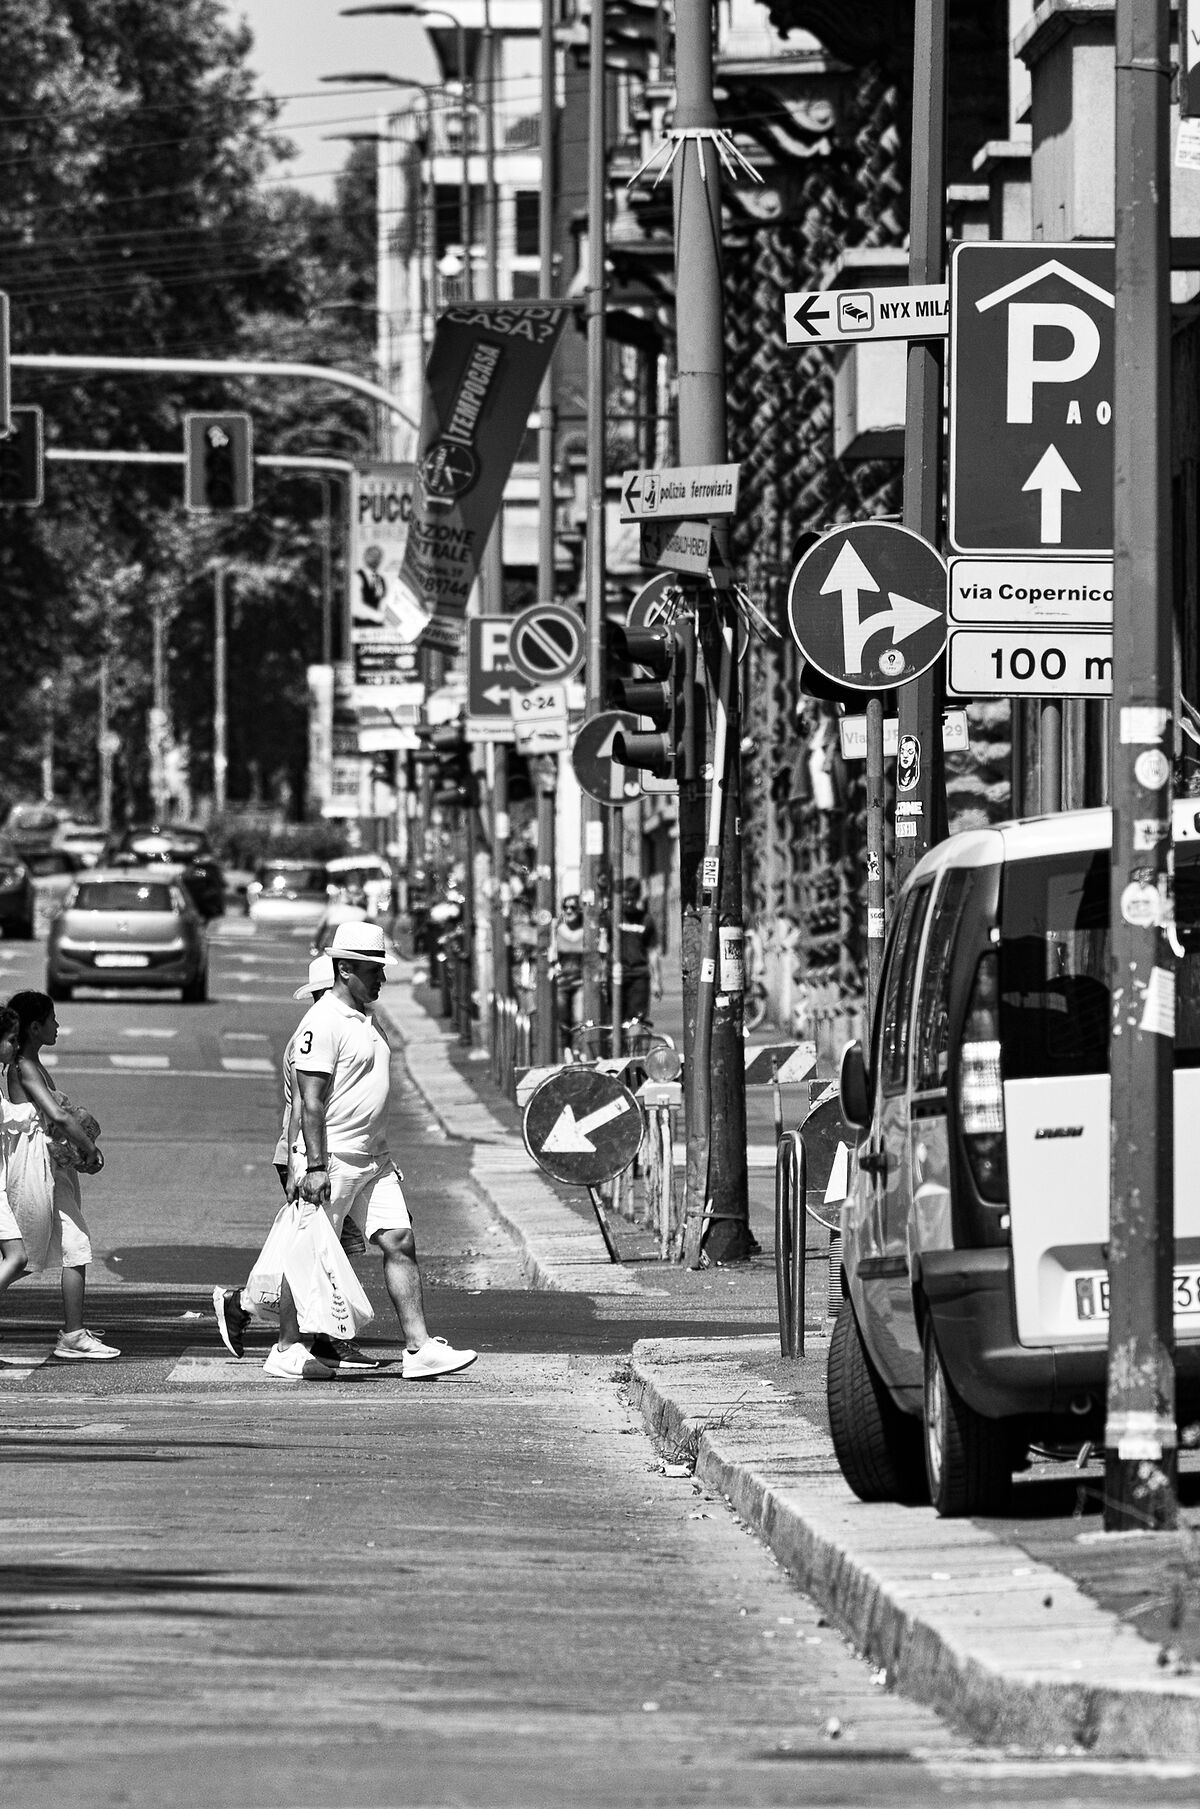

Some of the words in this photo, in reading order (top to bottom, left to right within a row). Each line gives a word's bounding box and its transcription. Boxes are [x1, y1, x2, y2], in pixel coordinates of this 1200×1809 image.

[880, 302, 910, 319] NYX
[1006, 302, 1100, 424] P
[449, 343, 501, 438] TEMPOCASA
[1066, 400, 1082, 424] A
[660, 482, 686, 503] polizia
[691, 479, 732, 498] ferroviaria
[960, 584, 992, 599] via
[999, 584, 1113, 604] Copernico
[991, 648, 1066, 680] 100
[1085, 657, 1113, 680] m
[522, 696, 555, 711] 0-24
[945, 724, 963, 737] 29
[300, 1031, 313, 1054] 3
